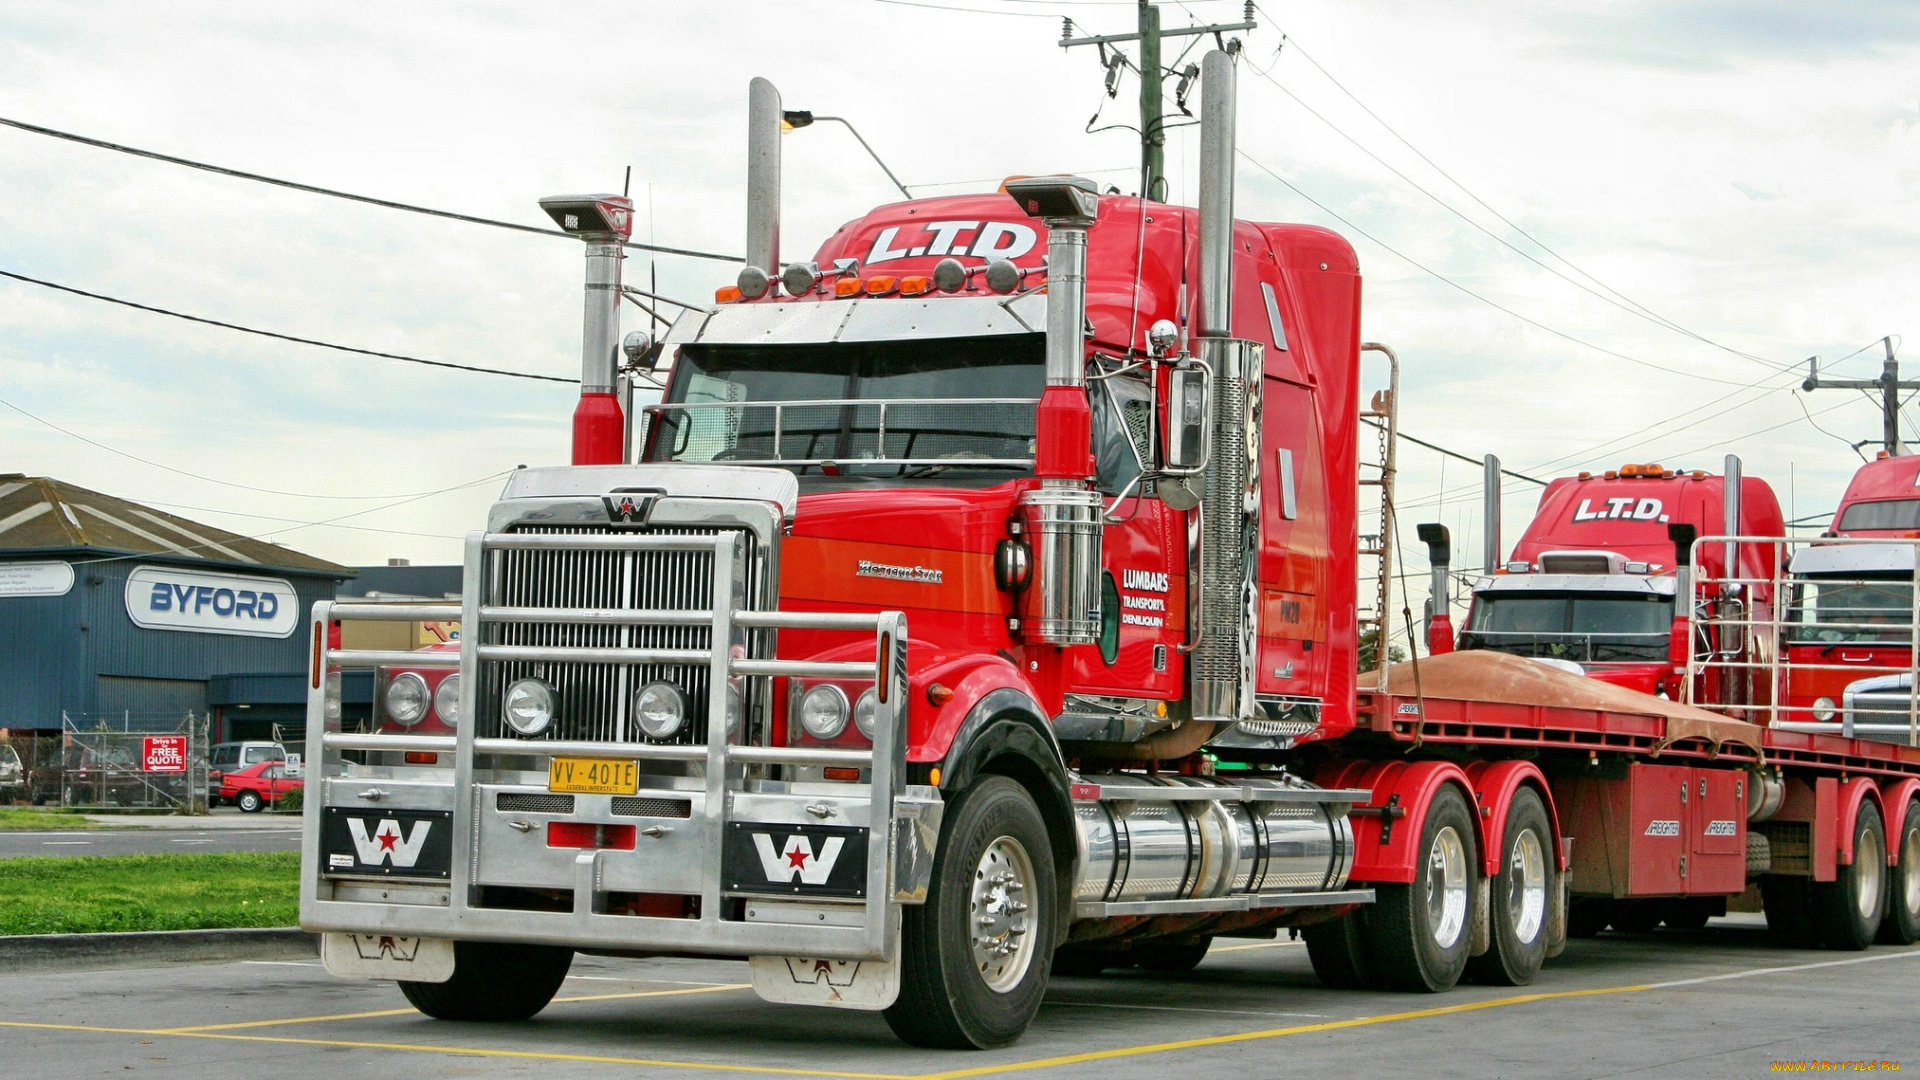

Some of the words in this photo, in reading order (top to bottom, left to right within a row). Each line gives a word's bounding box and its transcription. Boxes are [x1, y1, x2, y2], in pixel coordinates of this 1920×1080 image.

[1573, 497, 1670, 523] L.T.D.
[1123, 569, 1168, 592] LUMBARS
[150, 582, 278, 619] BYFORD
[147, 756, 182, 764] QUOTE
[151, 747, 178, 756] FREE
